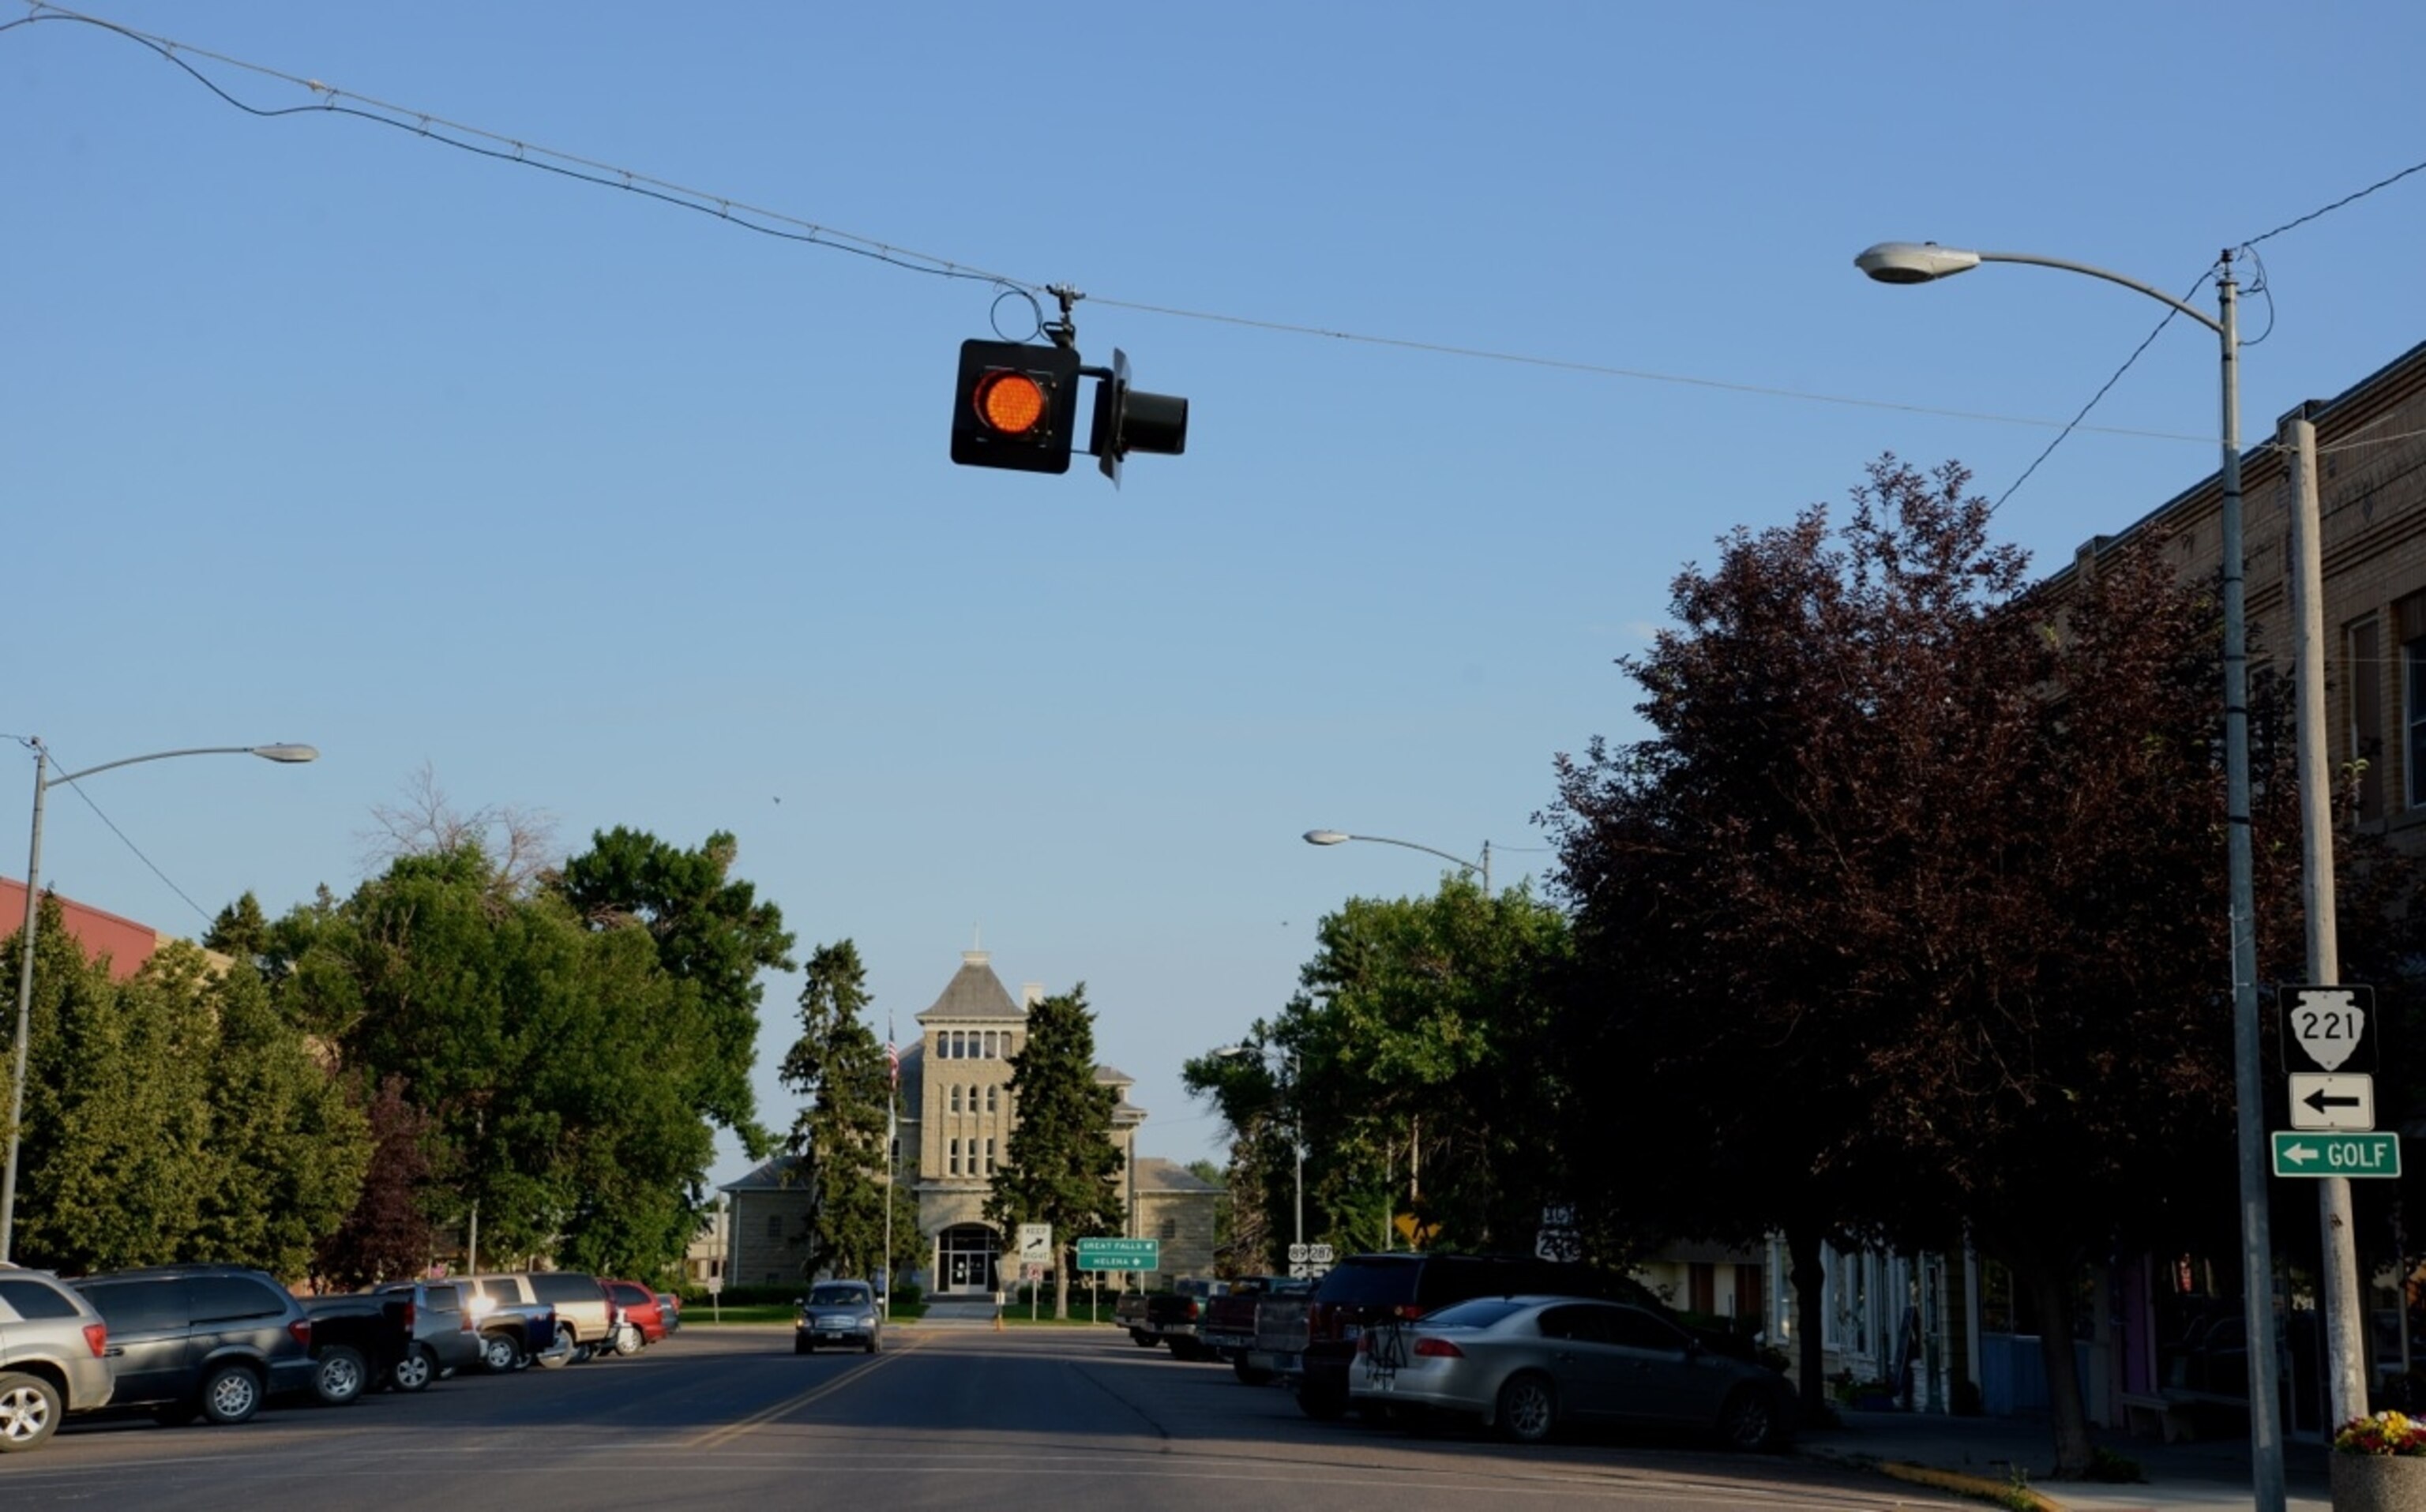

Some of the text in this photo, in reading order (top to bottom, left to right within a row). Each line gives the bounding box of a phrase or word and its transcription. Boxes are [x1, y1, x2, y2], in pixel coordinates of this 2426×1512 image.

[2301, 1011, 2354, 1040] 221
[2327, 1143, 2387, 1168] GOLF
[1290, 1247, 1307, 1259] 89
[1311, 1247, 1332, 1259] 287
[1093, 1257, 1129, 1266] HELENA
